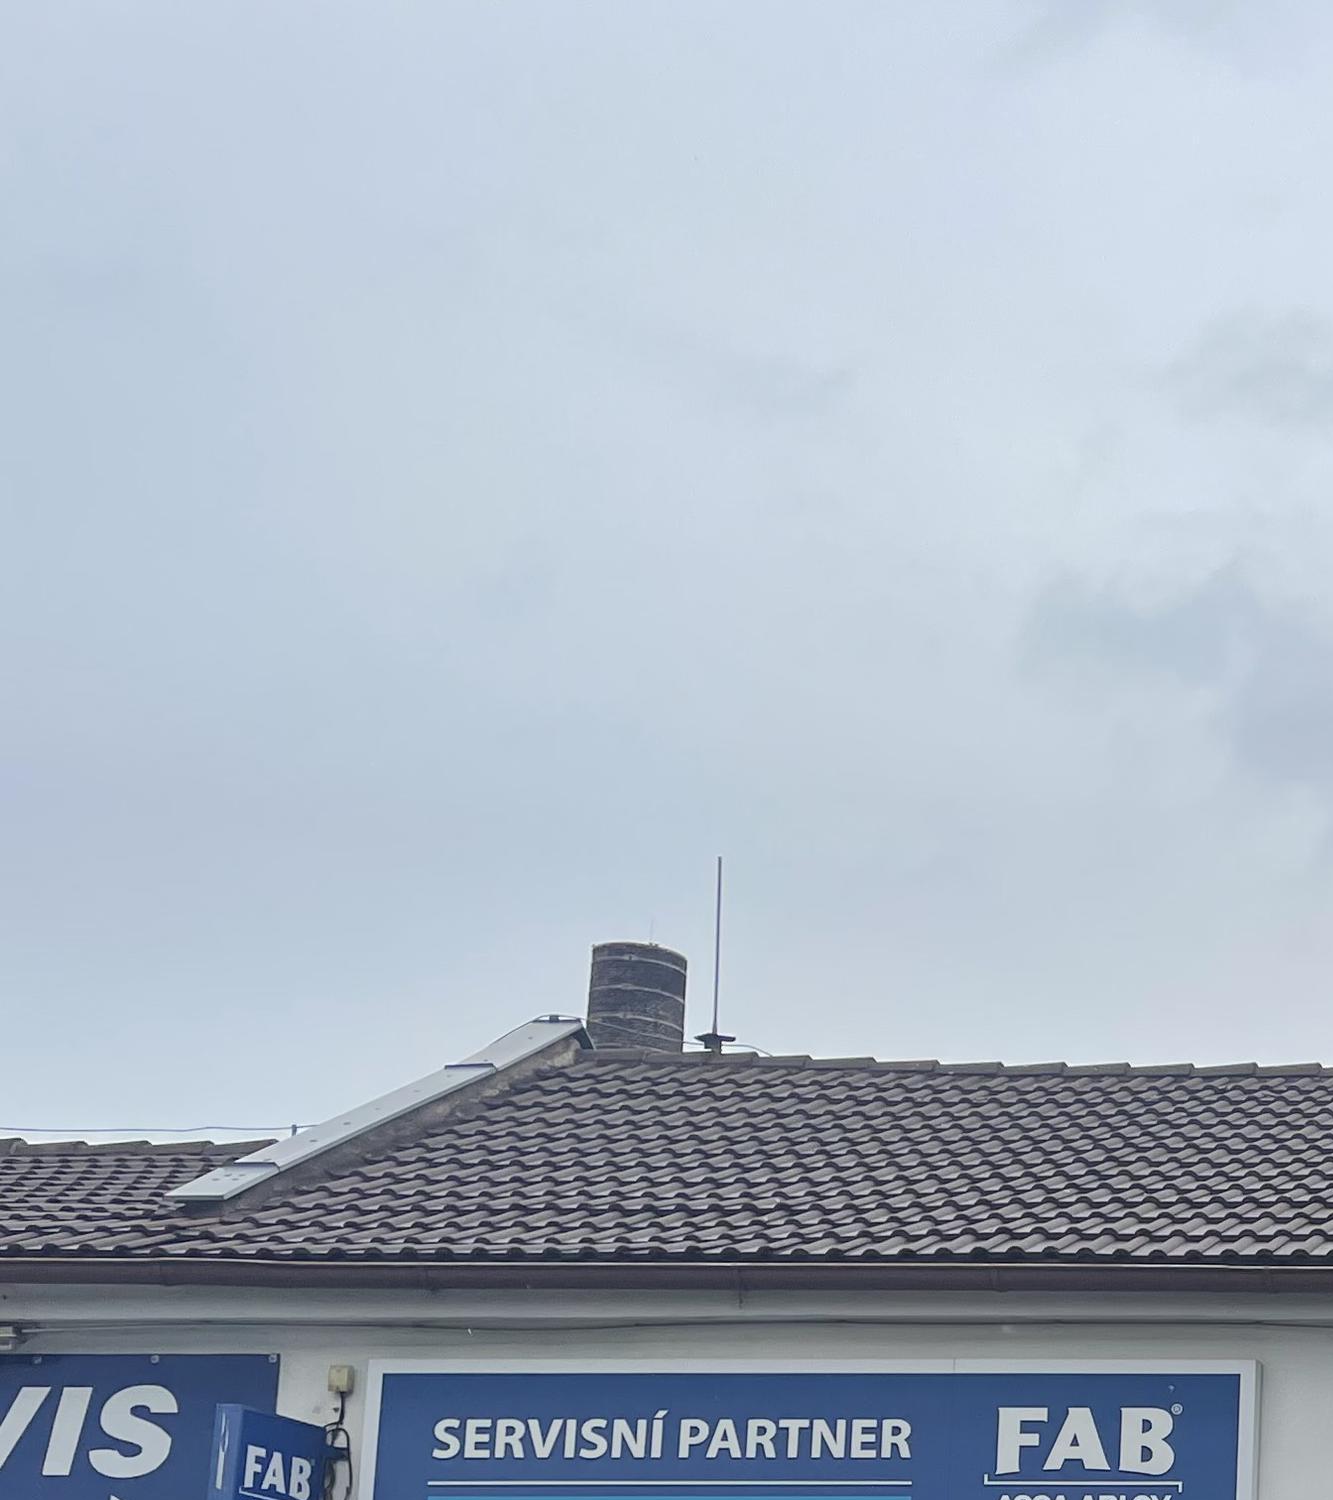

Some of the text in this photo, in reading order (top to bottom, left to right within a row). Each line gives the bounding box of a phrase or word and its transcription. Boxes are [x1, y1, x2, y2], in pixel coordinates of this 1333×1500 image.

[431, 1409, 912, 1460] SERVISNÍ PARTNER
[995, 1406, 1176, 1477] FAB
